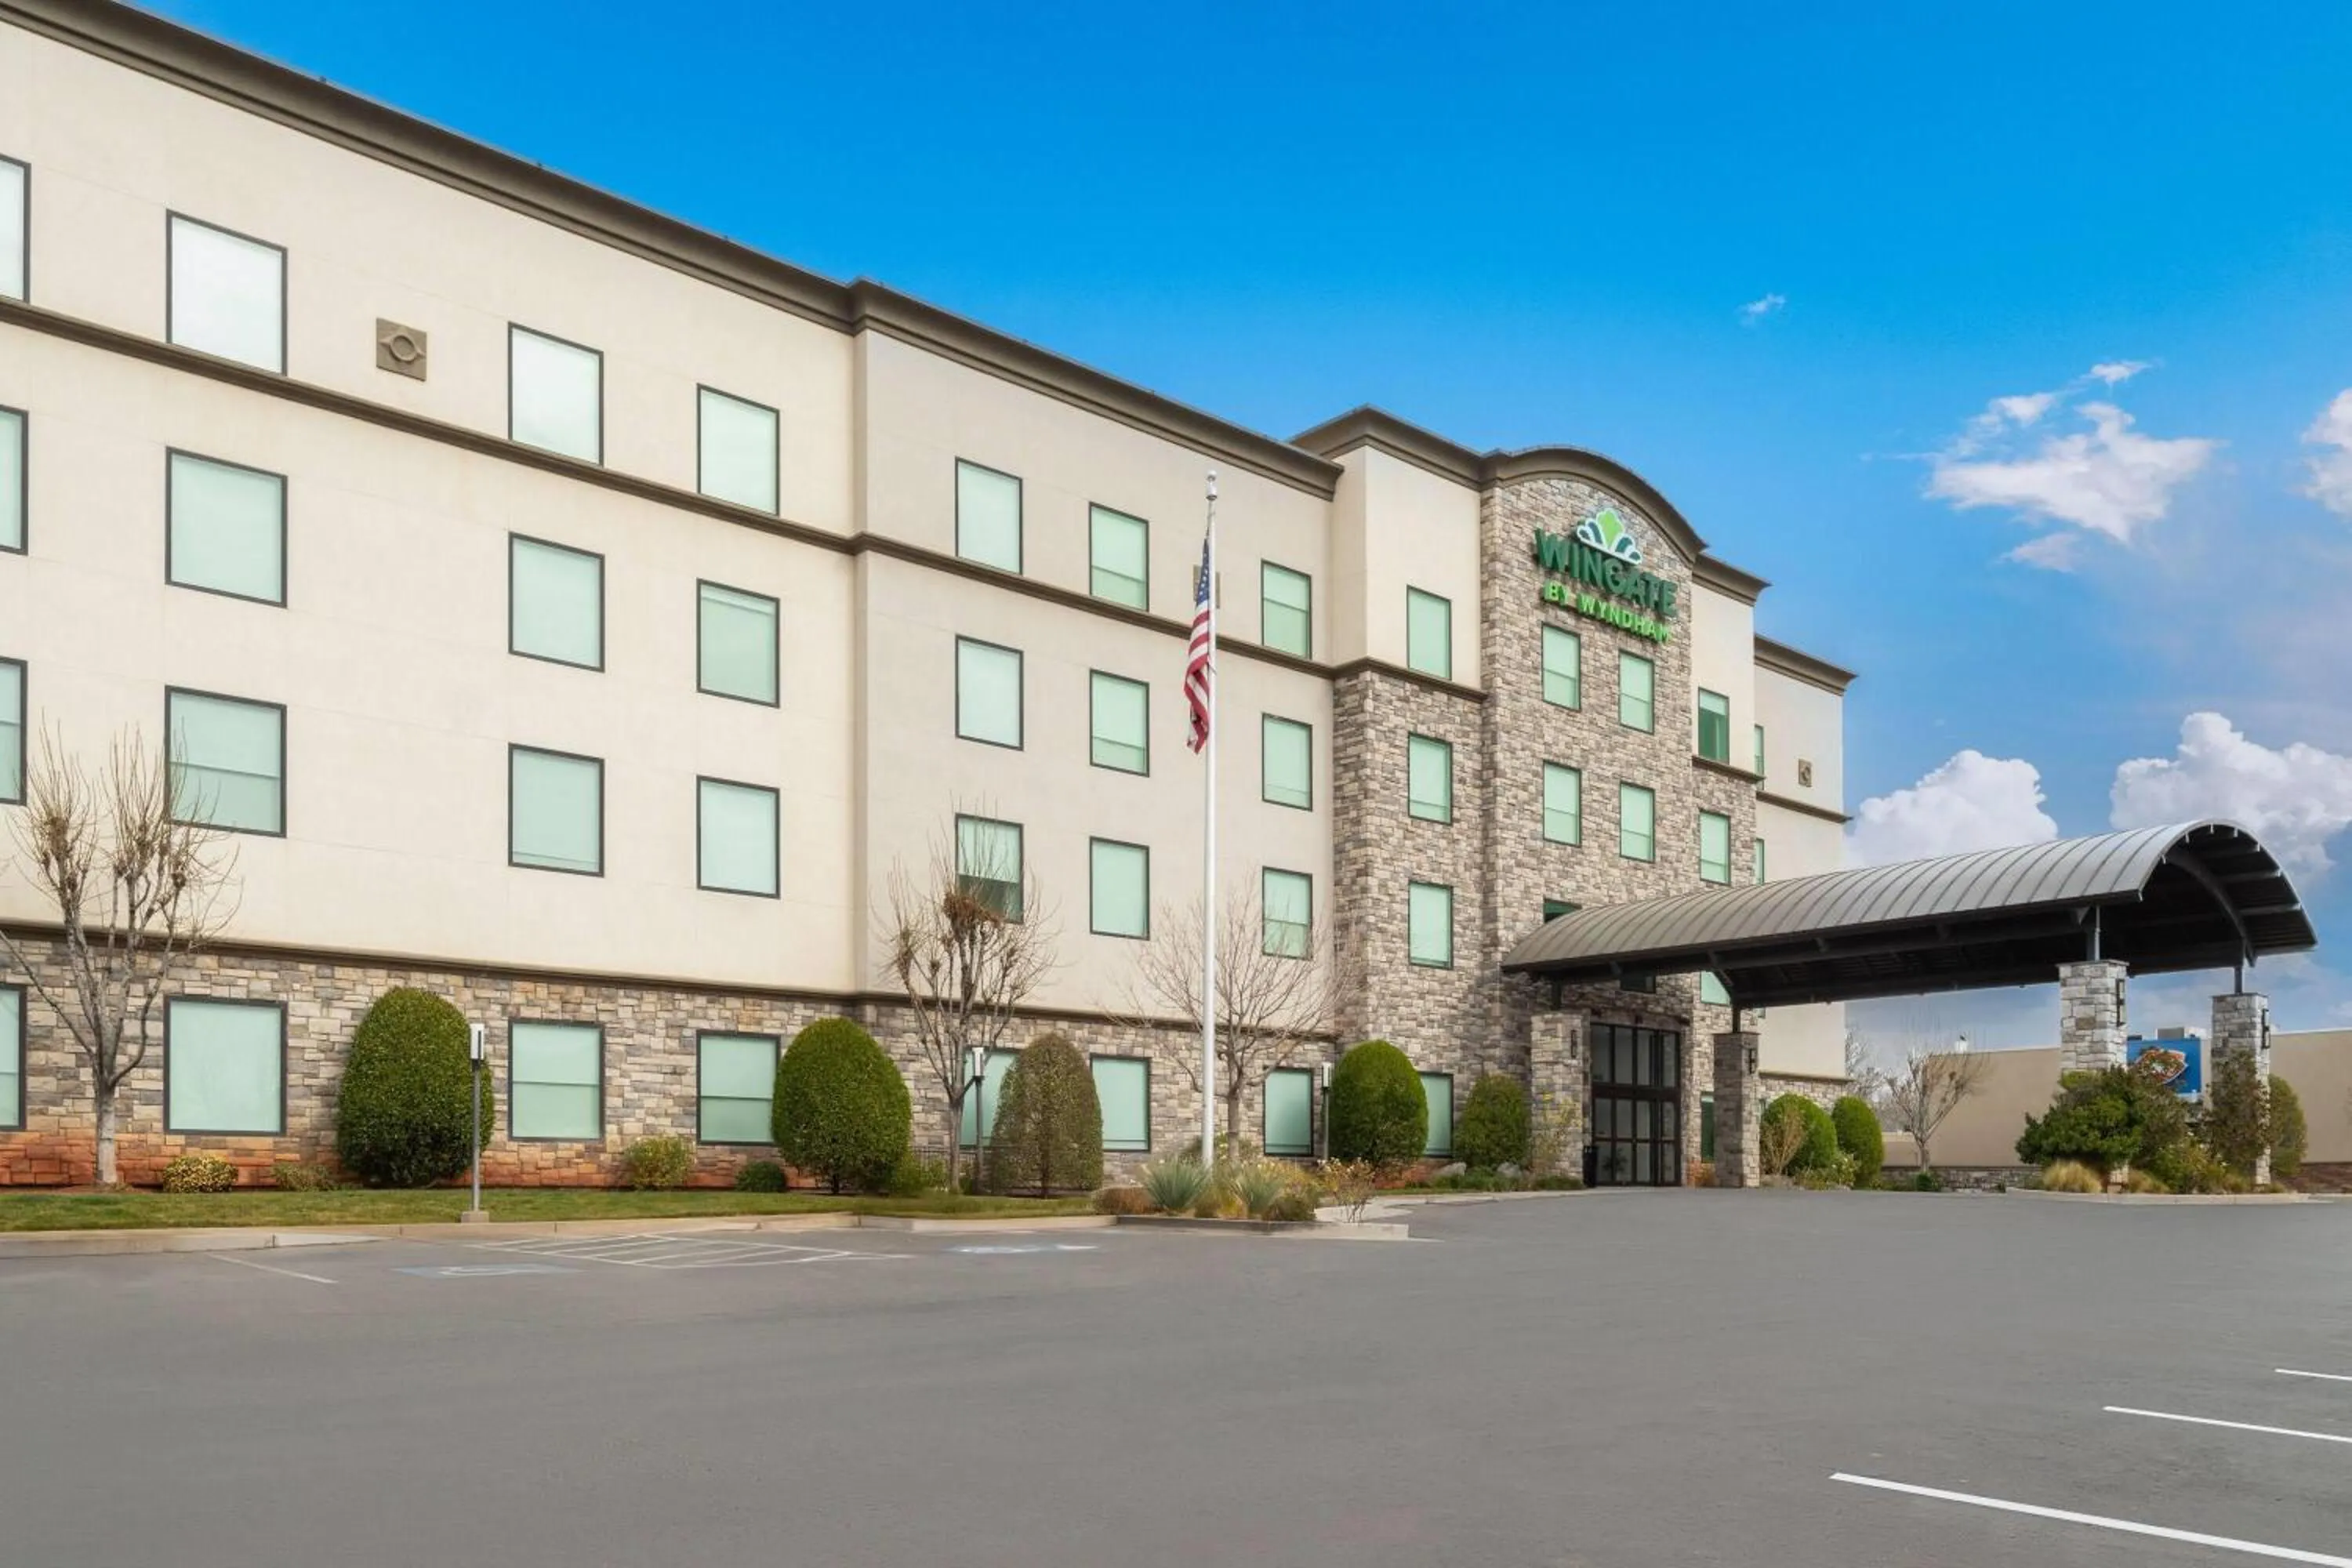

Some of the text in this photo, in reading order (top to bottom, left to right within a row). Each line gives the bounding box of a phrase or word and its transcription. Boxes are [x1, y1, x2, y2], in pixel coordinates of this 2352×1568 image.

[1534, 528, 1678, 618] WINGATE
[1544, 579, 1671, 643] BY WYNDHAM
